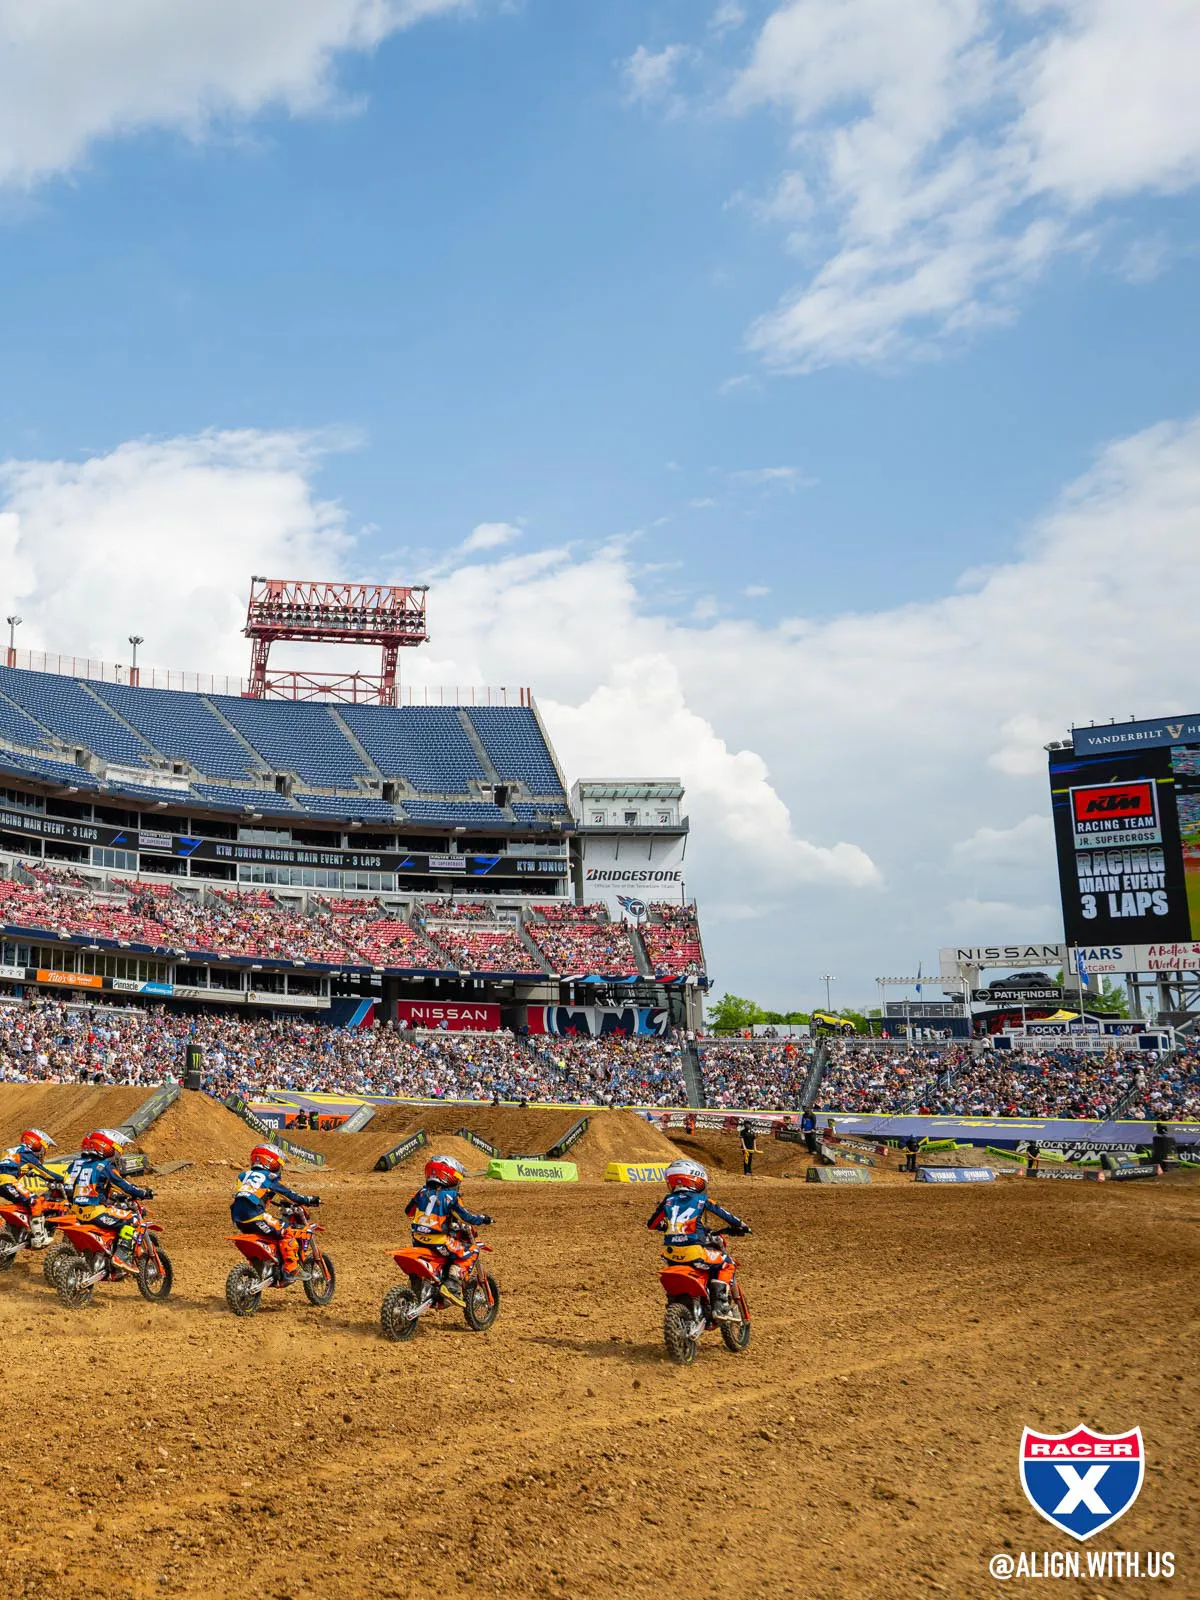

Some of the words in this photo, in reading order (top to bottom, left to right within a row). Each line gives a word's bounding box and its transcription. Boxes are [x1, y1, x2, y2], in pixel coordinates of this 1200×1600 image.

[1088, 729, 1163, 745] VANDERBILT
[1086, 794, 1140, 813] KTM
[43, 820, 65, 835] EVENT
[72, 826, 78, 837] 3
[79, 826, 98, 840] LAPS
[1077, 819, 1120, 832] RACING
[1123, 816, 1154, 829] TEAM
[1079, 837, 1092, 846] JR.
[1095, 832, 1156, 845] SUPERCROSS
[234, 846, 263, 859] JUNIOR
[265, 849, 294, 862] RACING
[297, 851, 318, 863] MAIN
[320, 854, 344, 865] EVENT
[352, 855, 357, 866] 3
[361, 856, 381, 867] LAPS
[1075, 847, 1165, 877] RACING
[516, 860, 535, 871] KTM
[586, 868, 682, 882] BRIDGESTONE
[1078, 876, 1120, 893] MAIN
[1123, 873, 1166, 891] EVENT
[1081, 894, 1097, 919] 3
[1108, 890, 1169, 918] LAPS
[958, 945, 1059, 960] NISSAN
[1148, 945, 1157, 956] A
[1148, 956, 1179, 970] World
[1183, 957, 1196, 969] For
[48, 972, 67, 984] Tito's
[113, 979, 139, 991] Pinnacle
[994, 989, 1060, 999] PATHFINDER
[411, 1007, 488, 1021] NISSAN
[1035, 1139, 1072, 1150] ROCKY
[1073, 1140, 1137, 1151] MOUNTAIN
[517, 1164, 563, 1179] Kawasaki
[627, 1167, 667, 1183] SUZU
[242, 1170, 267, 1189] 13
[669, 1205, 697, 1233] 14
